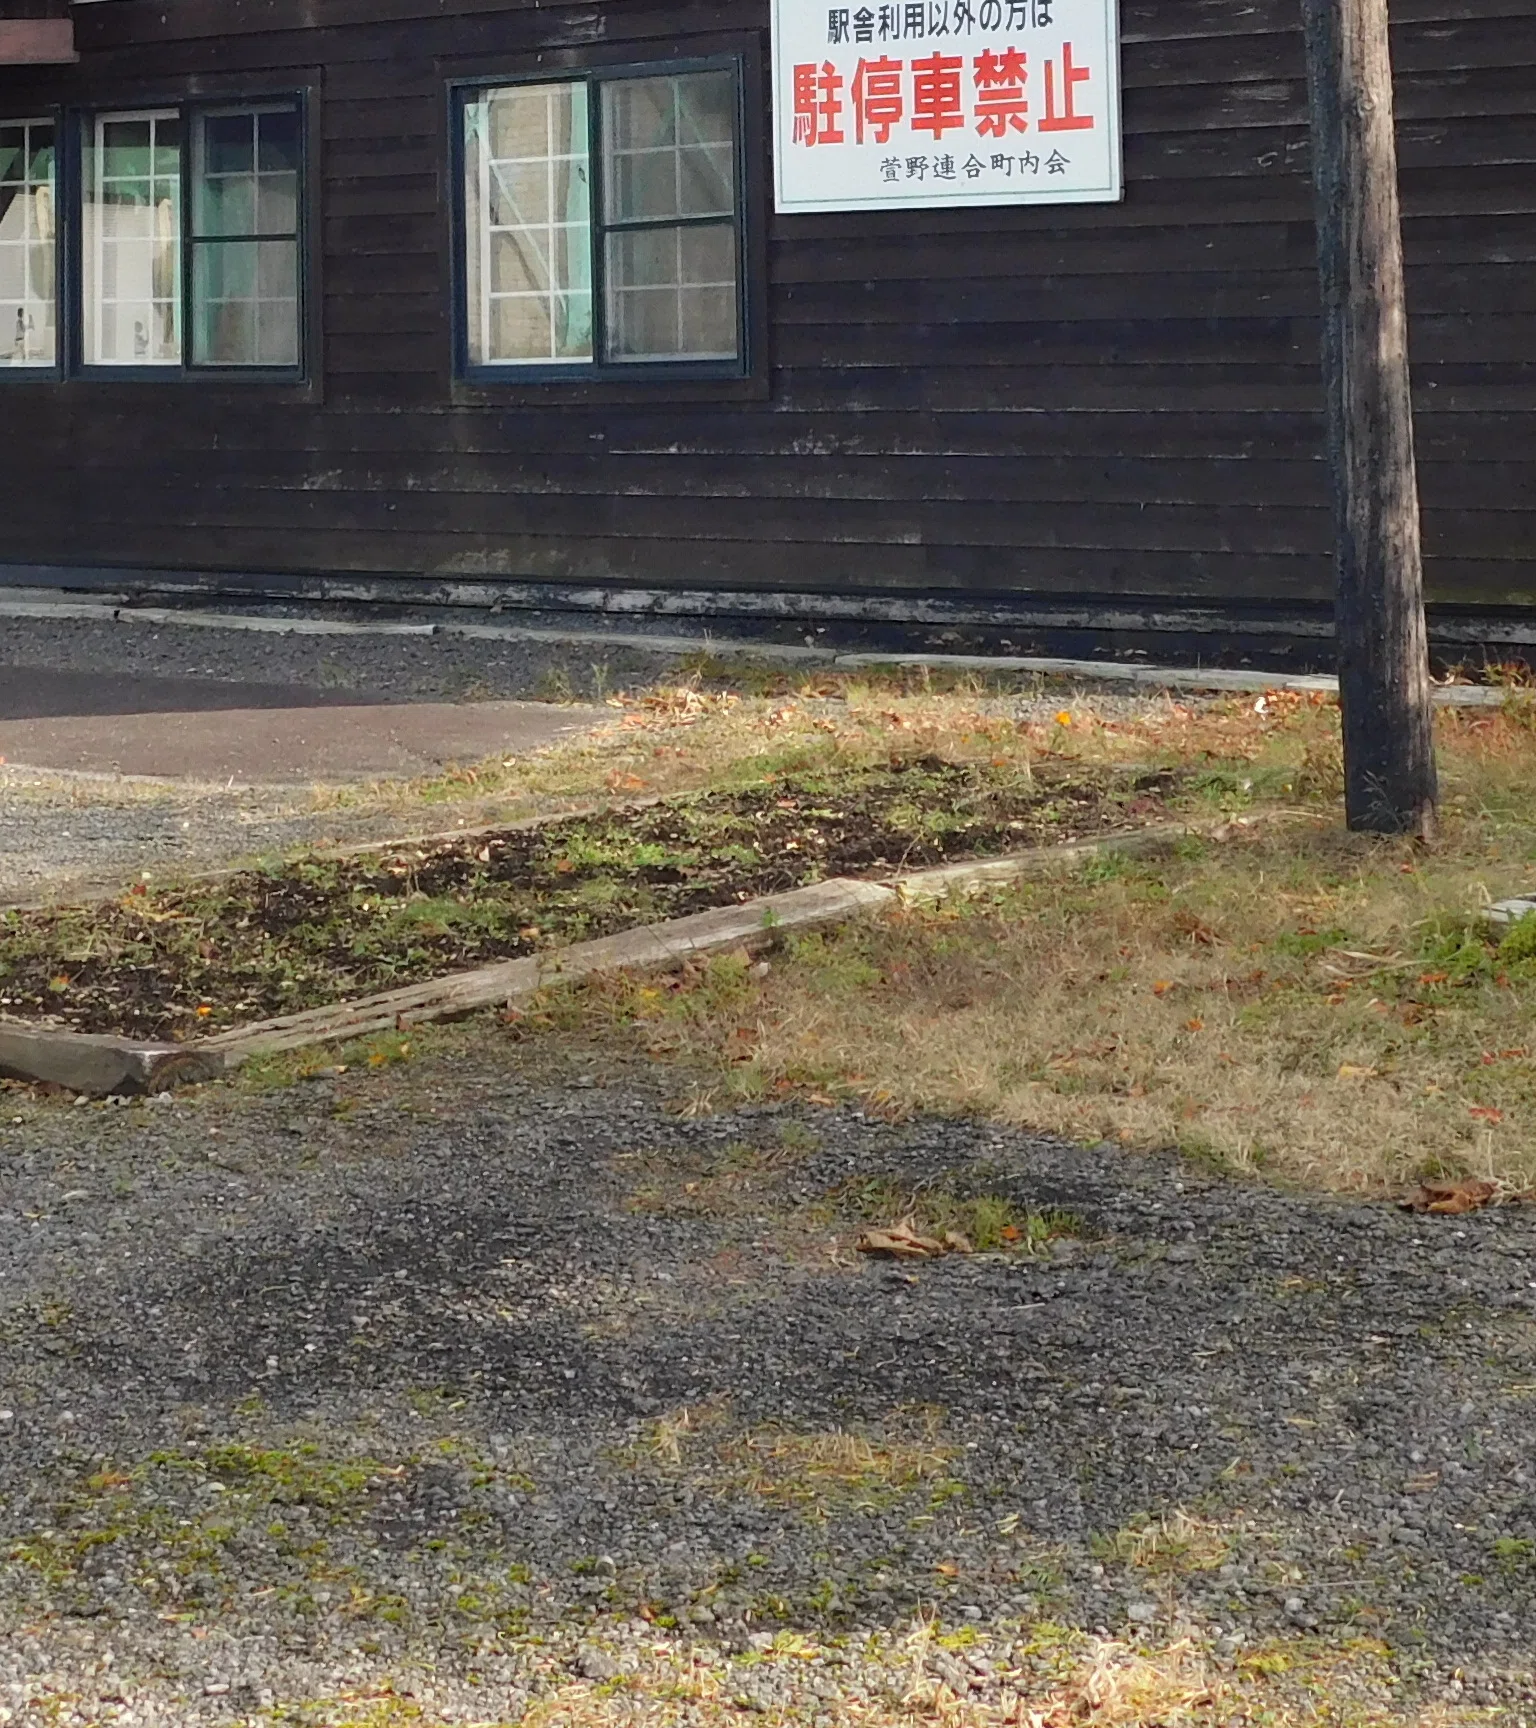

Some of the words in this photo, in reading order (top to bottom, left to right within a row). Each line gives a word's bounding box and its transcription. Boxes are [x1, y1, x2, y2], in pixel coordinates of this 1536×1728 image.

[792, 41, 1095, 147] 駐停車禁止
[879, 148, 1071, 183] 萱野連合町内会
